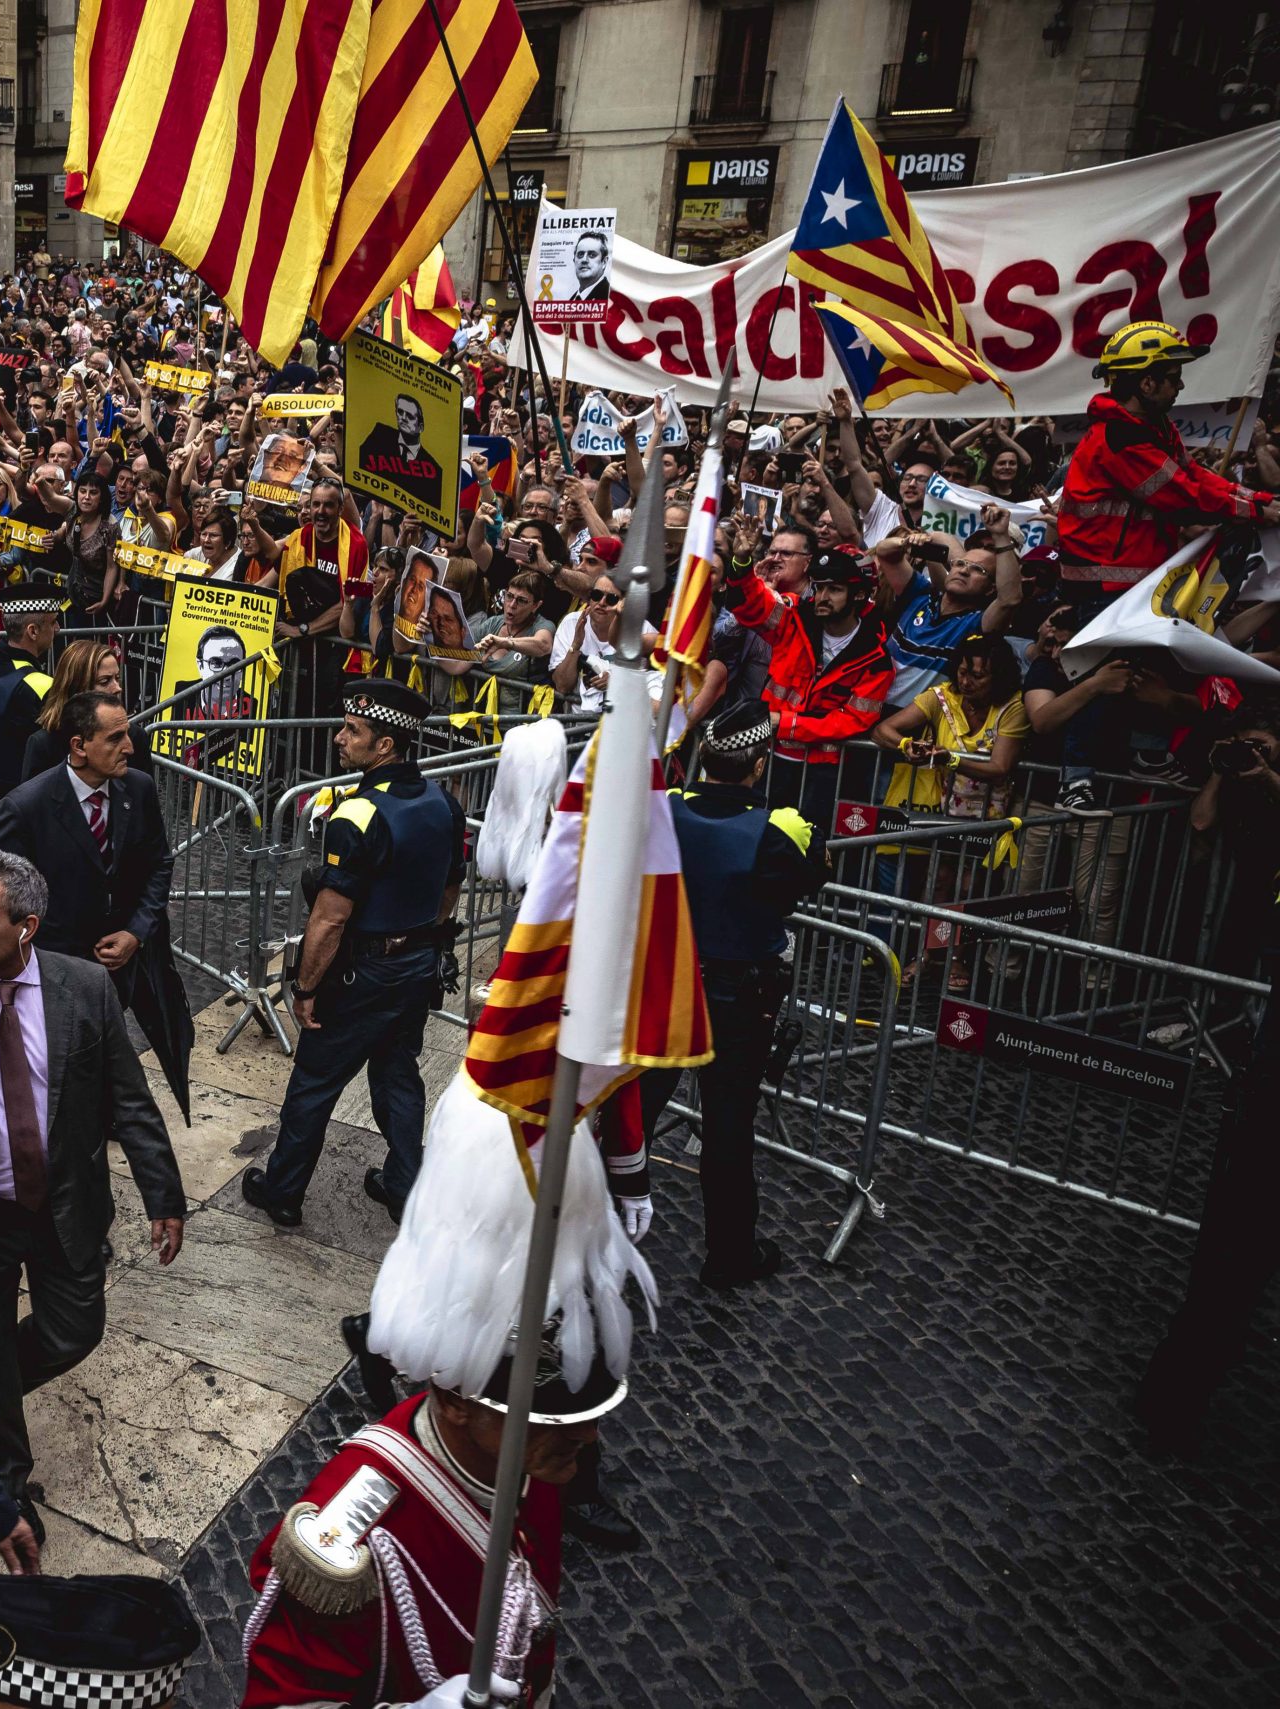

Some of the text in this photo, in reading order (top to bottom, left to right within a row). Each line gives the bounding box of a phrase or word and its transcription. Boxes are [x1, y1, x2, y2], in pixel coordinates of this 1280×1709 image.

[713, 158, 770, 185] pans
[898, 153, 966, 180] pans
[937, 171, 964, 182] COMPANY
[747, 173, 768, 186] COMPANY
[542, 216, 615, 230] LLIBERTAT
[535, 303, 606, 312] EMPRESONAT
[356, 339, 452, 392] JOAQUIM FORN
[369, 354, 394, 371] Minister
[402, 371, 413, 380] the
[414, 376, 438, 391] Interior
[363, 356, 374, 365] the
[374, 363, 411, 385] Government
[420, 385, 449, 404] Catalonia
[266, 397, 336, 411] ABSOLUCIÓ
[364, 454, 437, 479] JAILED
[353, 470, 451, 529] STOP FASCISM
[11, 527, 27, 541] LU
[118, 549, 134, 562] AB
[136, 554, 154, 567] SO
[184, 587, 273, 615] JOSEP RULL
[181, 610, 227, 625] Government
[239, 620, 269, 633] Catalonia
[185, 602, 218, 616] Territory
[220, 608, 251, 620] Minister
[260, 617, 269, 625] the
[155, 656, 162, 665] de
[1014, 911, 1024, 921] de
[1027, 905, 1066, 919] Barcelona
[995, 1031, 1175, 1090] Ajuntament de Barcelona
